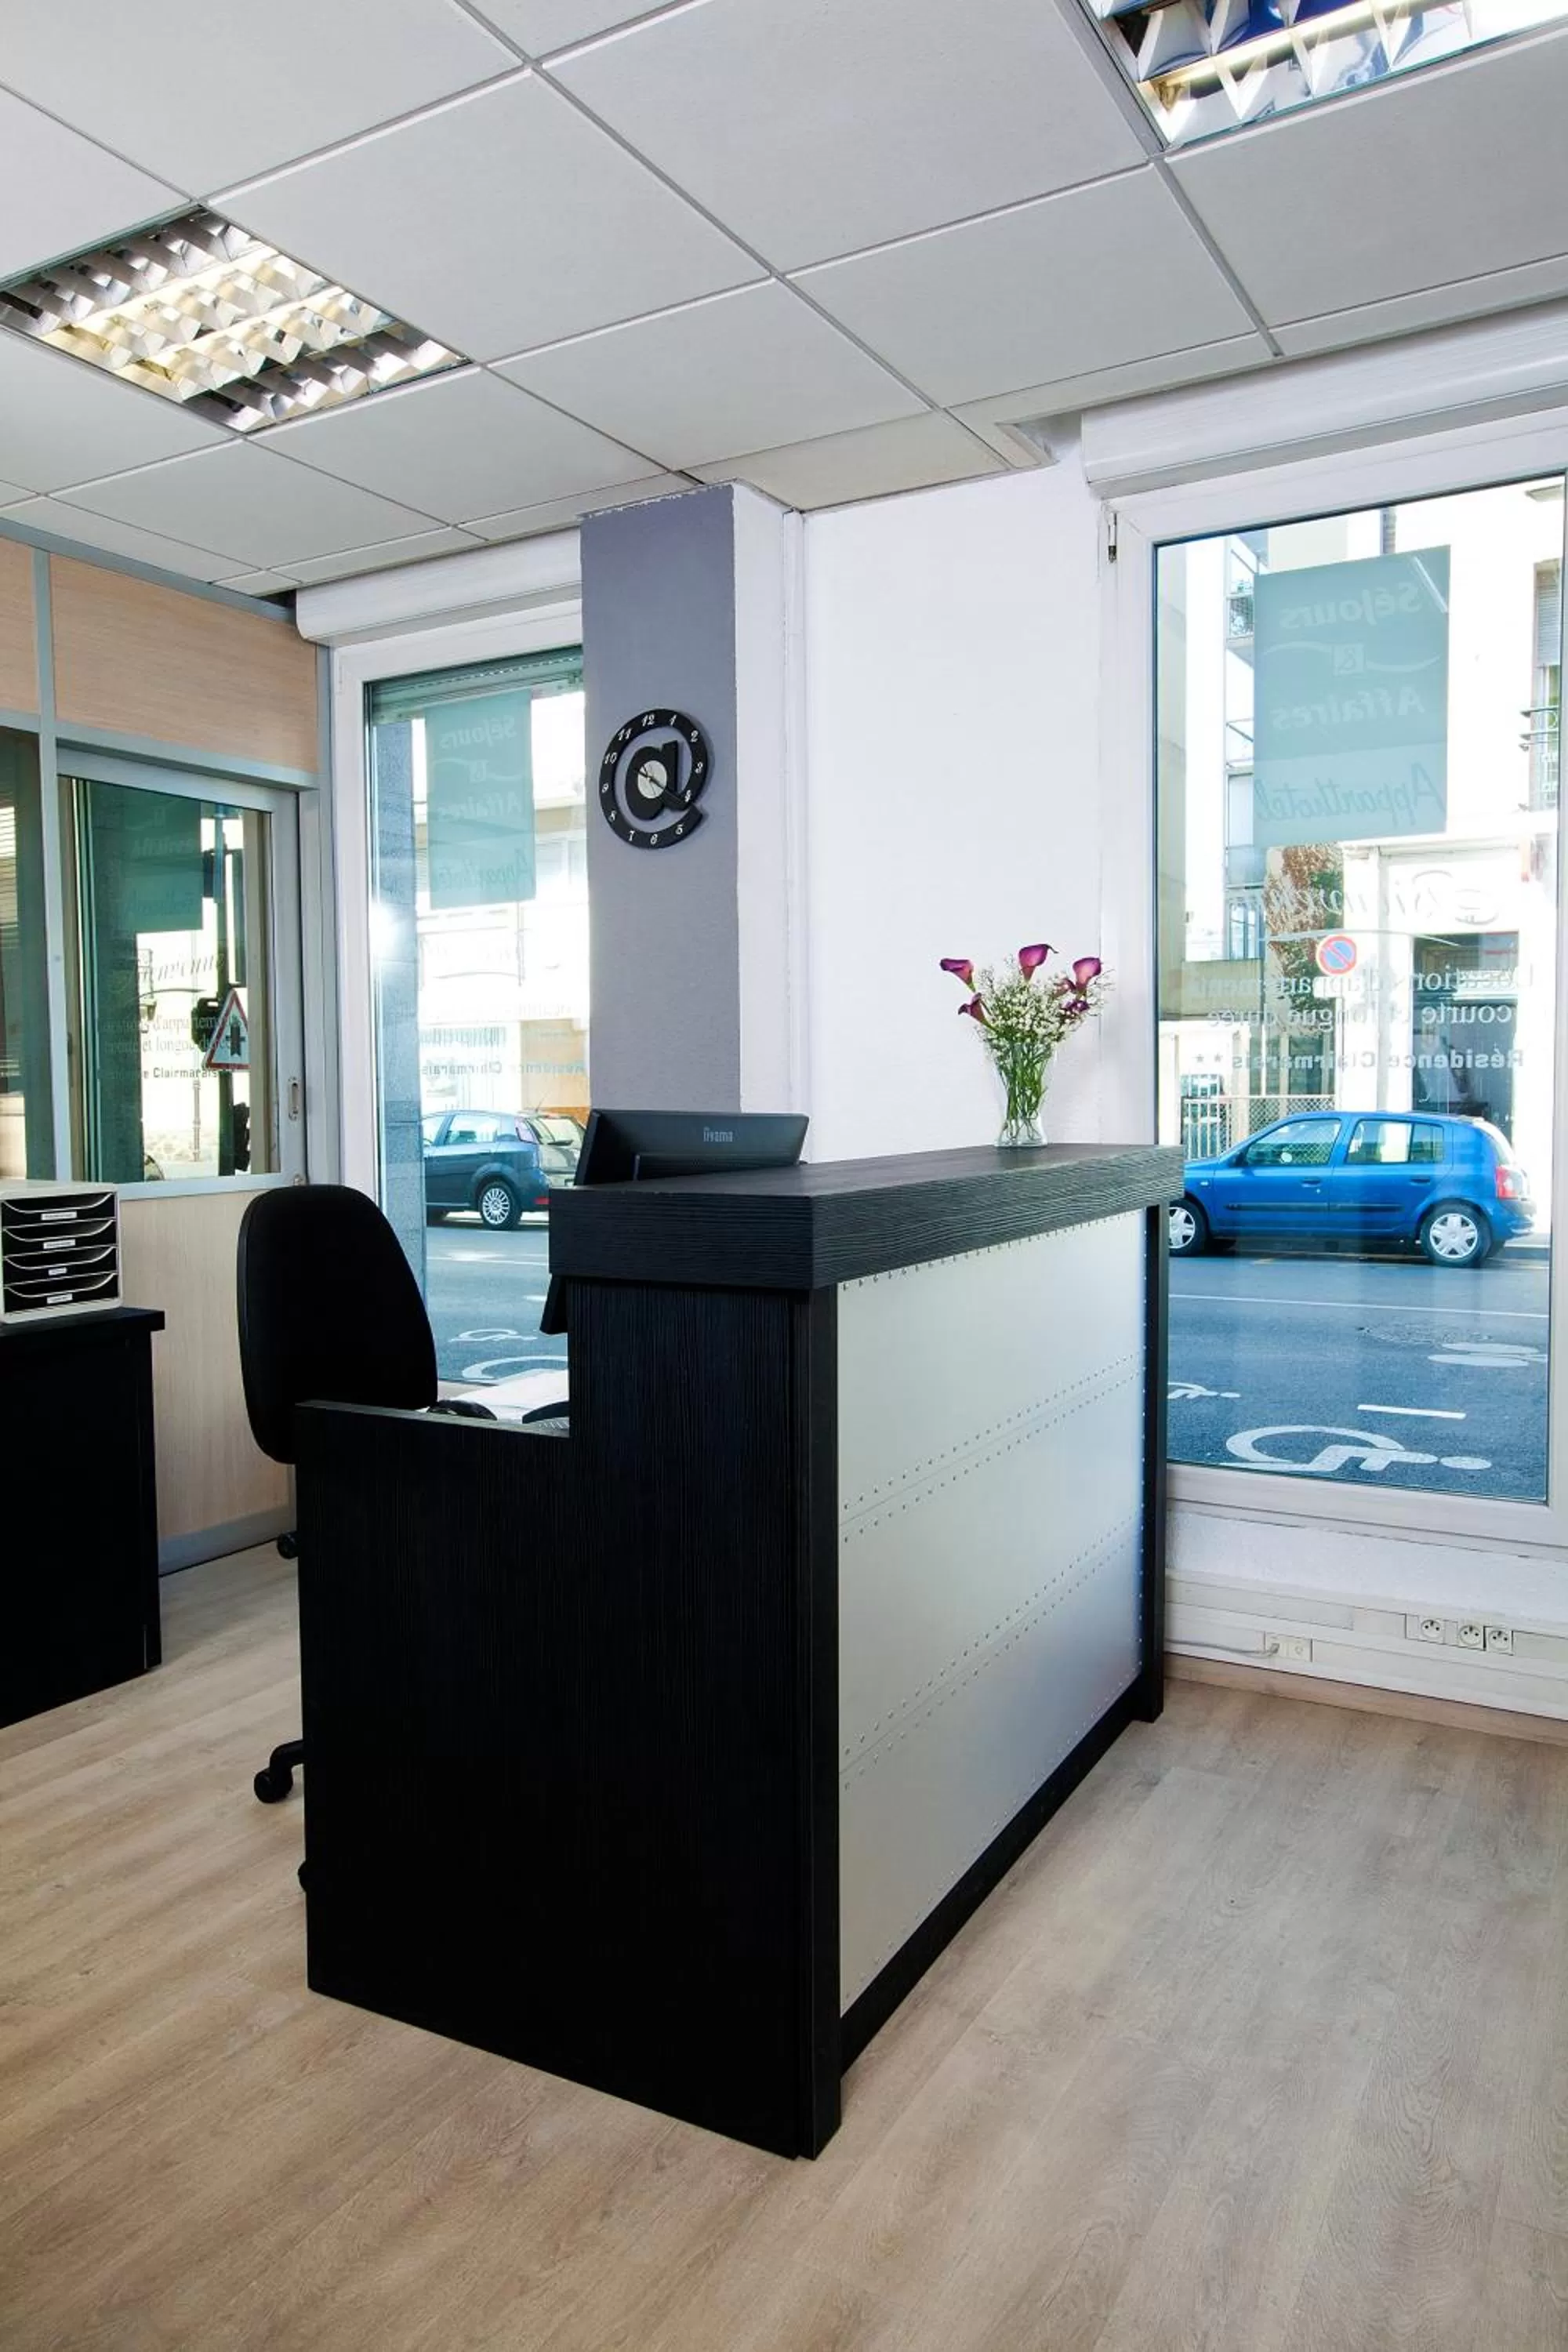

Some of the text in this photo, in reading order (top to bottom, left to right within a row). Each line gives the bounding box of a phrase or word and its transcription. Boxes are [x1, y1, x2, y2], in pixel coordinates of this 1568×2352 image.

[641, 714, 656, 728] 12
[669, 714, 677, 726] 1
[618, 728, 632, 741] 11
[690, 730, 699, 743] 2
[604, 752, 619, 765] 10
[695, 762, 704, 774] 3
[601, 782, 609, 793] 9
[608, 810, 617, 822] 8
[674, 823, 685, 836] 5
[627, 830, 636, 842] 7
[650, 833, 659, 845] 6
[153, 1066, 218, 1080] Clairmarais
